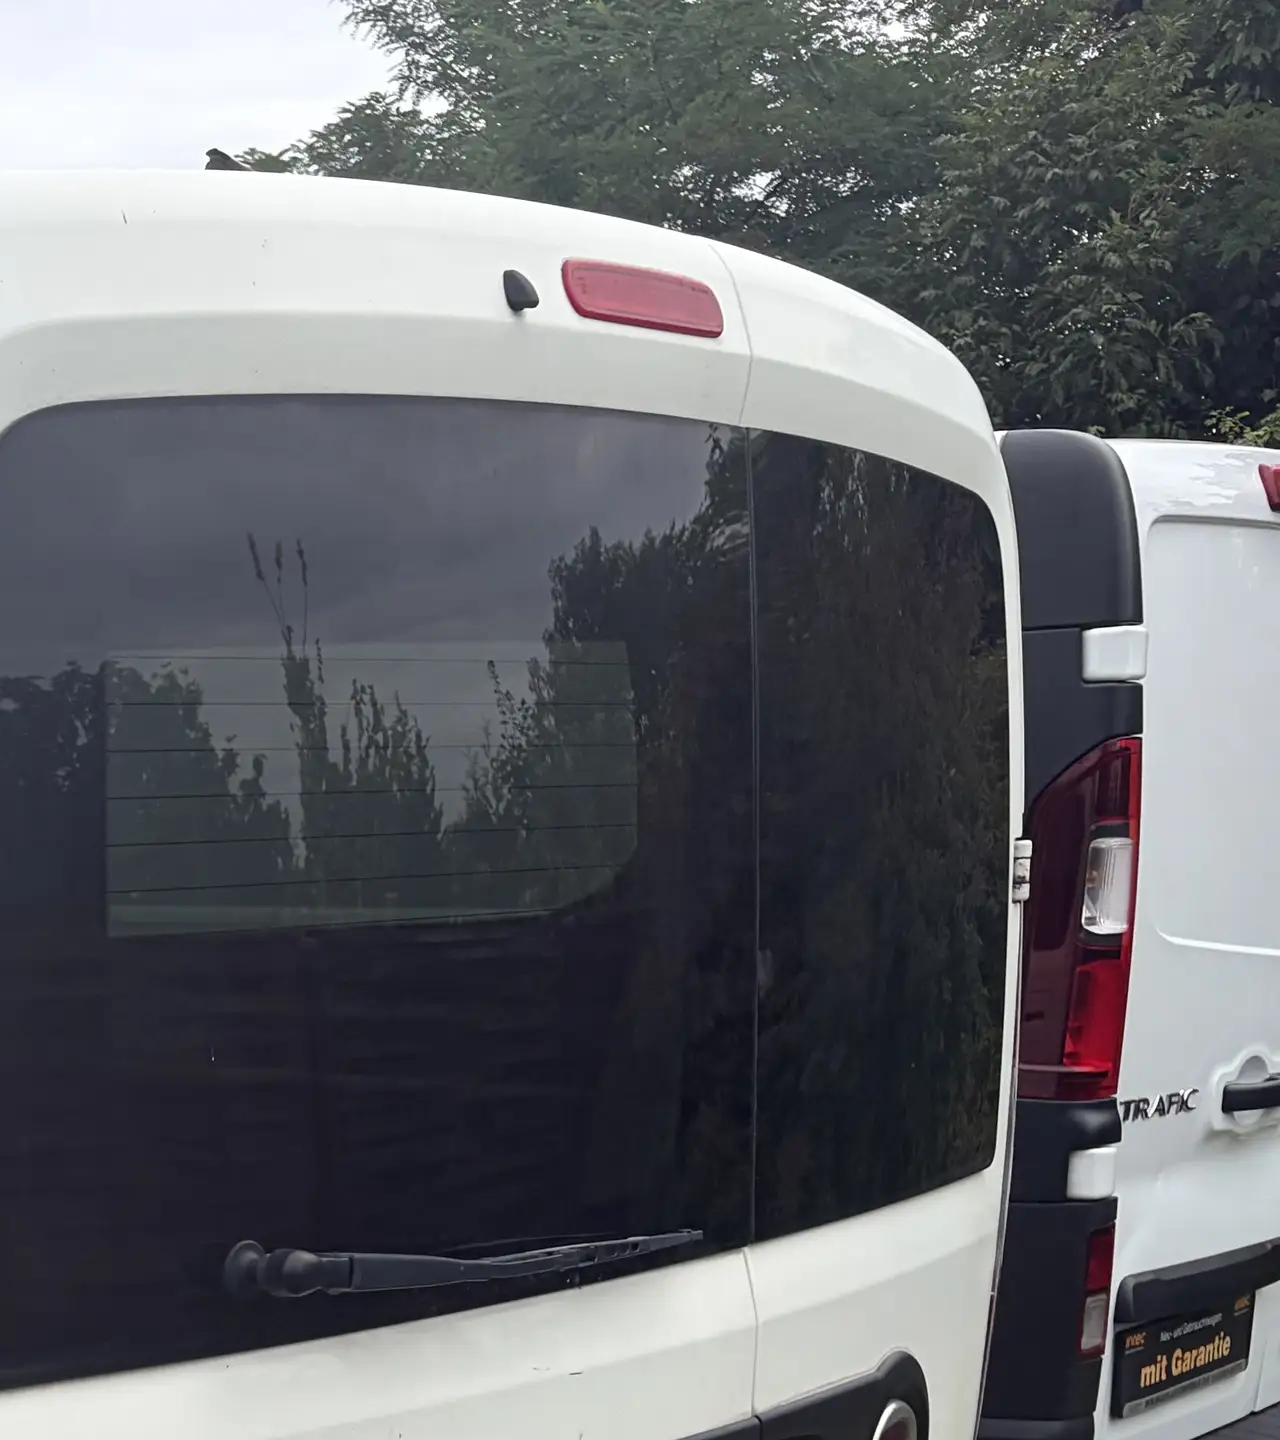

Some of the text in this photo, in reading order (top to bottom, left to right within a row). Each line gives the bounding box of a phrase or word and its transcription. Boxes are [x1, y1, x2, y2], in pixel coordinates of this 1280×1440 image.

[1119, 1088, 1199, 1122] TRAFIC
[1140, 1354, 1168, 1388] mit
[1171, 1331, 1231, 1376] Garantie
